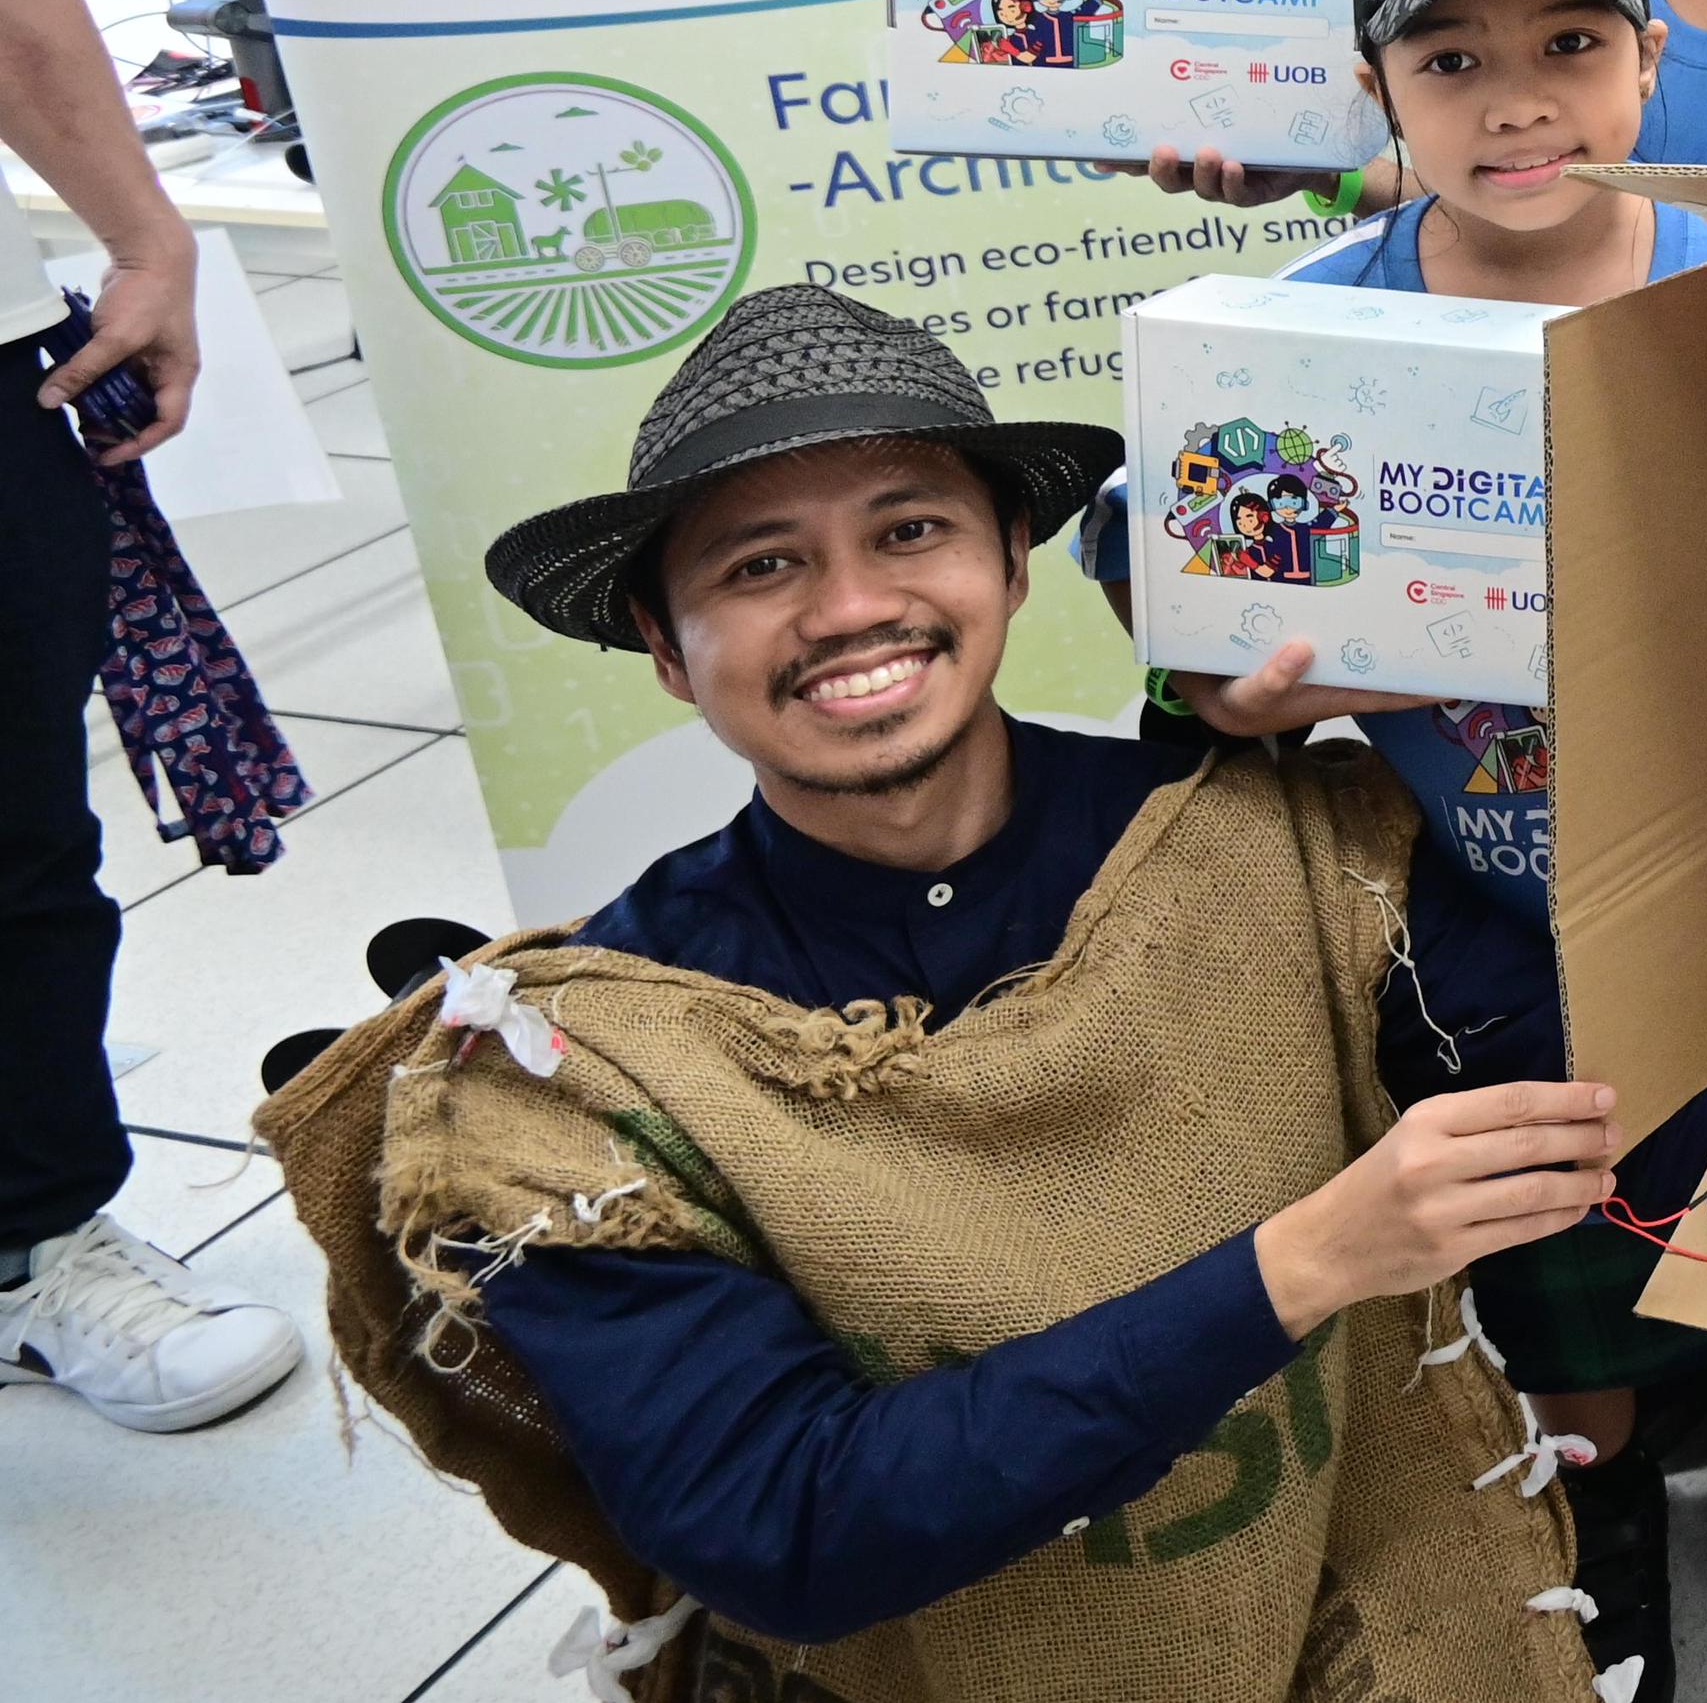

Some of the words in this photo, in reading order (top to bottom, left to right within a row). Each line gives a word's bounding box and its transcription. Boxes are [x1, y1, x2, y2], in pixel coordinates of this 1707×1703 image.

[1274, 65, 1327, 84] UOB
[805, 251, 967, 288] Design
[981, 216, 1249, 271] eco-friendly
[1263, 216, 1358, 245] sma
[986, 303, 1031, 329] or
[1044, 289, 1168, 324] farm
[1380, 461, 1424, 487] MY
[1380, 489, 1547, 527] BOOTCAM
[1512, 591, 1547, 613] UO
[1457, 806, 1513, 841] MY
